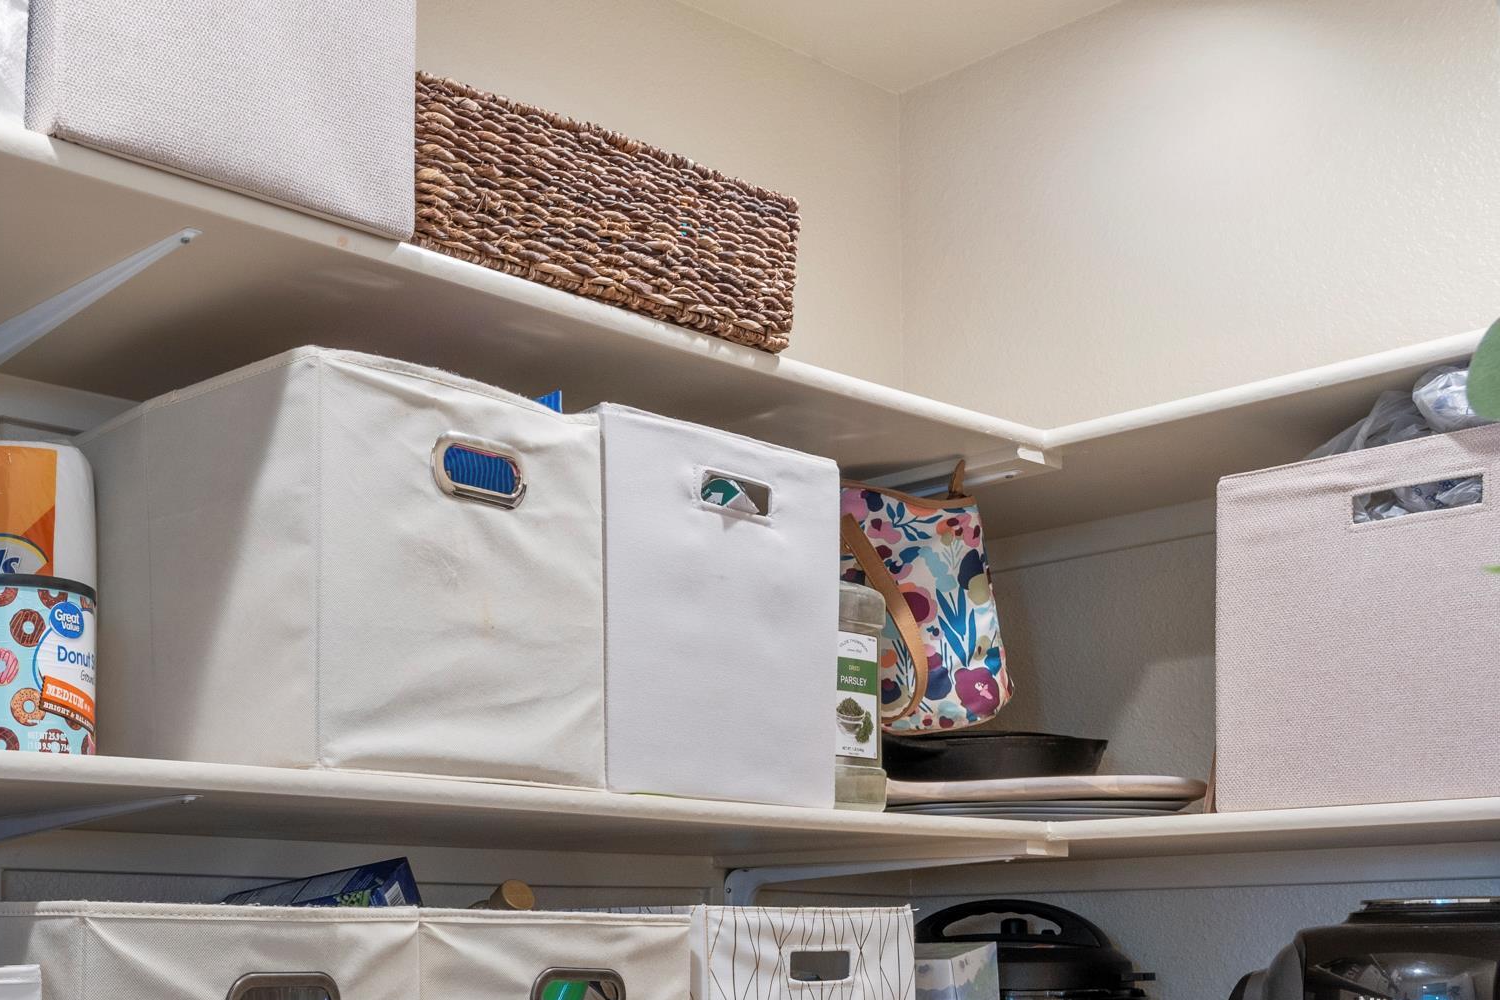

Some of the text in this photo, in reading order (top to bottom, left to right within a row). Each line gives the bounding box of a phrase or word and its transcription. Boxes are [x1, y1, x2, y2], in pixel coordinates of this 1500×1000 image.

[54, 608, 80, 625] Great
[61, 620, 80, 632] Value
[57, 645, 91, 669] Donut
[840, 675, 868, 687] PARSLEY
[45, 683, 85, 710] MEDIUM
[43, 701, 70, 716] BRIGHT
